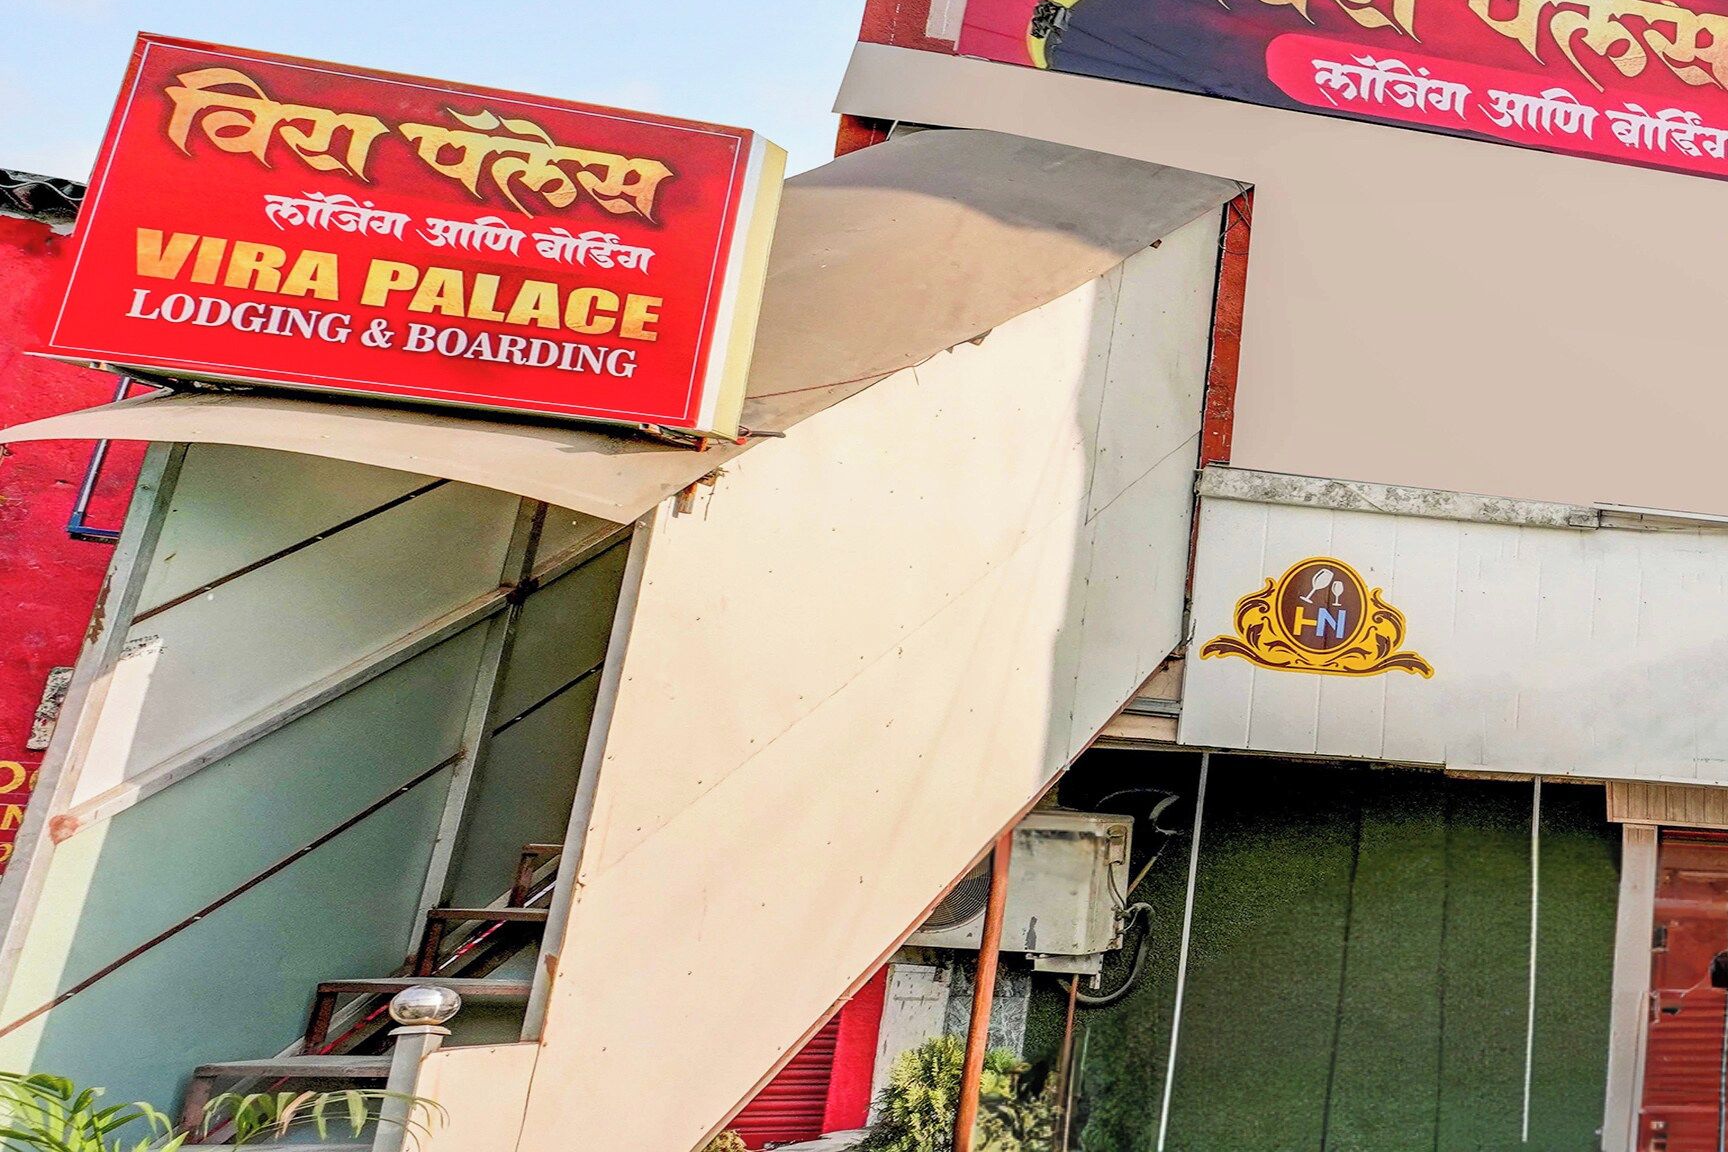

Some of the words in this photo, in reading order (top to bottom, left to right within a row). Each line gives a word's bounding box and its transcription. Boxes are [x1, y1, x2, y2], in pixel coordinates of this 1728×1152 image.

[164, 67, 389, 183] विरा
[1477, 87, 1600, 142] आणि
[417, 215, 521, 258] आणि
[134, 227, 340, 302] VIRA
[360, 258, 664, 343] PALACE
[125, 288, 352, 348] LODGING
[360, 318, 393, 350] &
[403, 322, 639, 379] BOARDING
